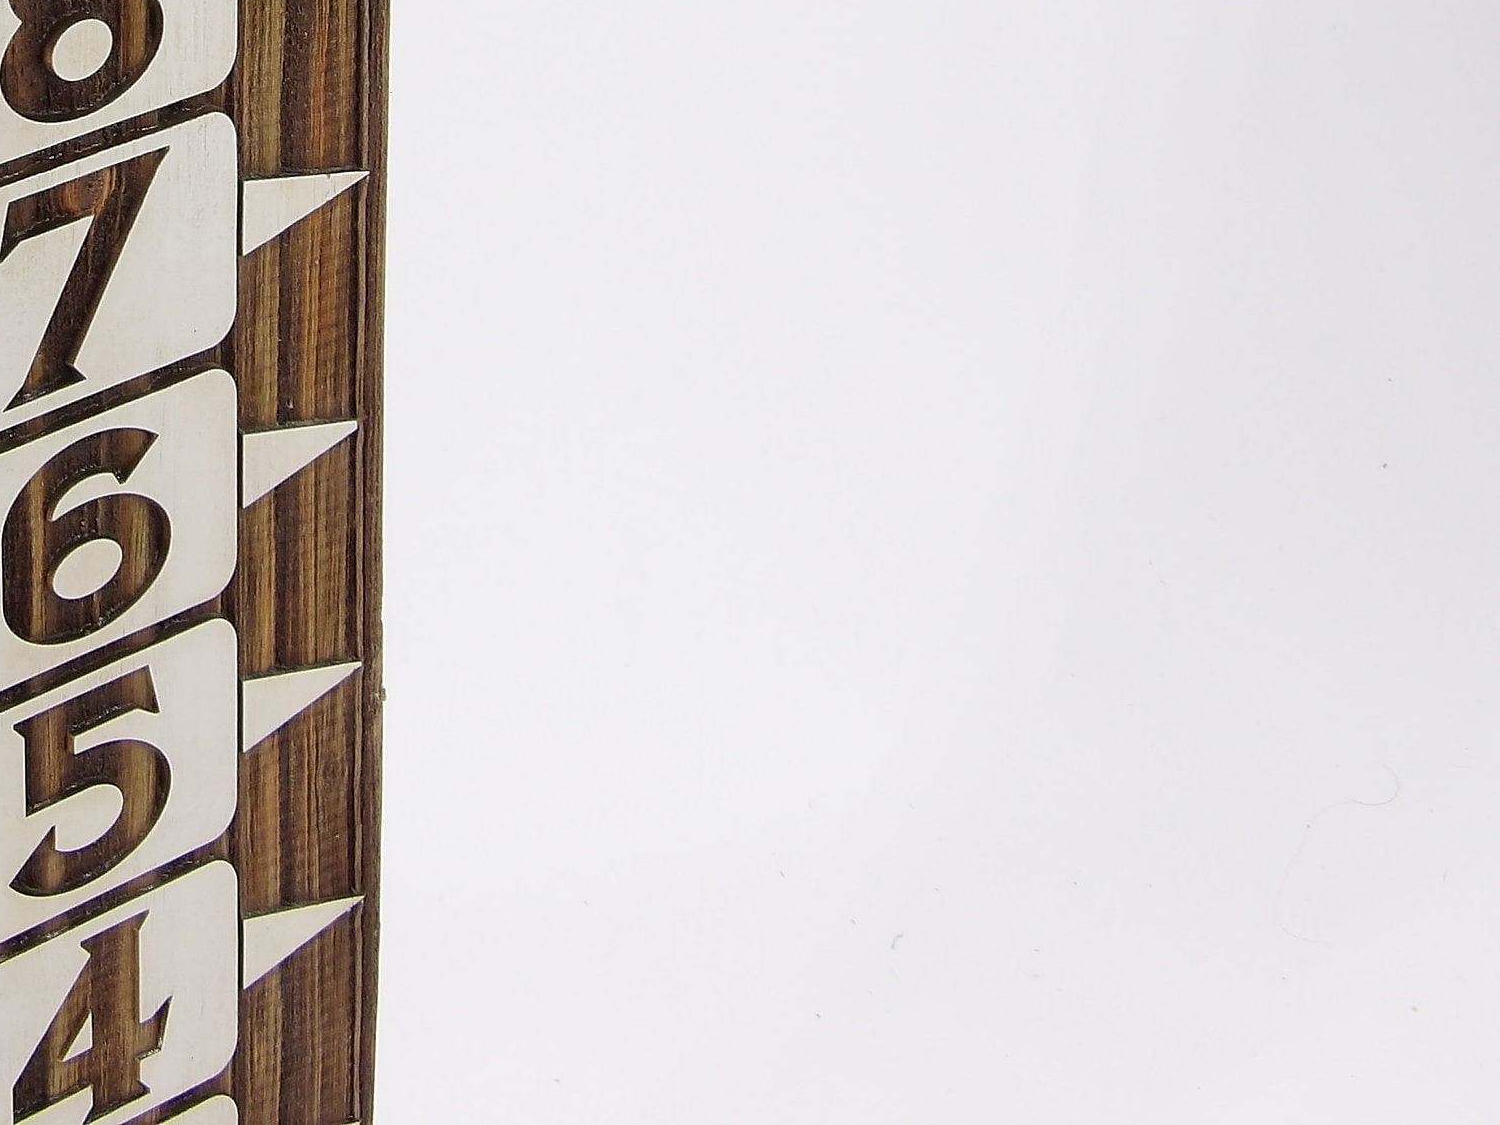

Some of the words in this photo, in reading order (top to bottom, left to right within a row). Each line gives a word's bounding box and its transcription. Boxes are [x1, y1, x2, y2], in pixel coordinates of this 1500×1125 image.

[1, 426, 173, 646] 6
[8, 664, 173, 899] 5
[12, 909, 173, 1125] 4
